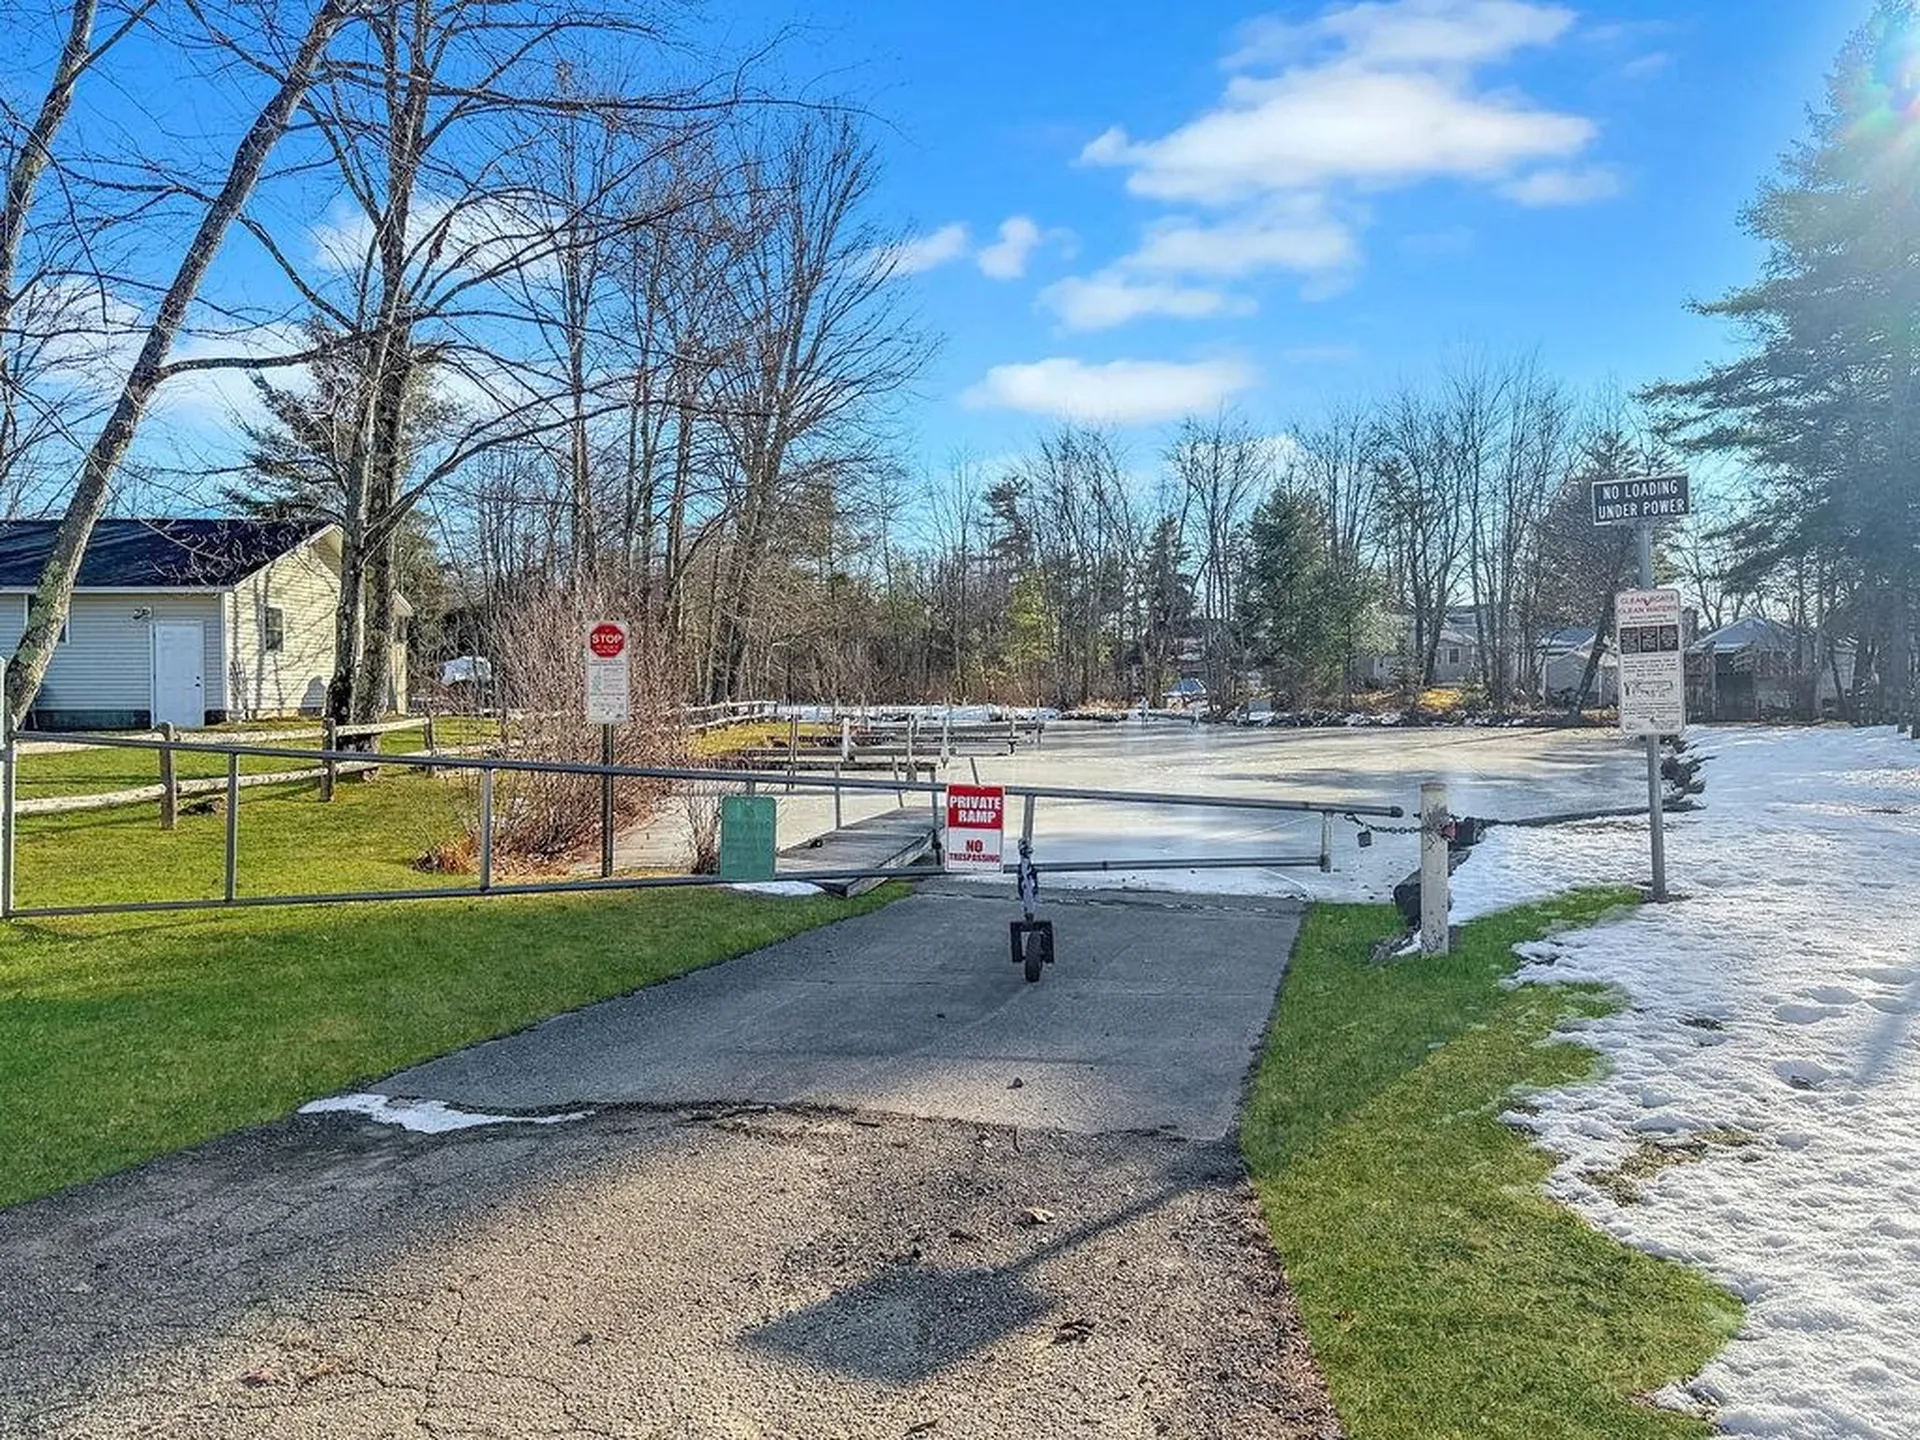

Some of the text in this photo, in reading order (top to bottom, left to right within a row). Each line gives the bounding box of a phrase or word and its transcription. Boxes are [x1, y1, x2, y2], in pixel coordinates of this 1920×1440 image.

[1602, 480, 1678, 500] NO LOADING
[1598, 498, 1685, 519] UNDER POWER
[591, 633, 623, 644] STOP
[949, 795, 1002, 810] PRIVATE
[958, 809, 997, 823] RAMP
[965, 839, 984, 853] NO
[948, 852, 1000, 863] TRESPASSING
